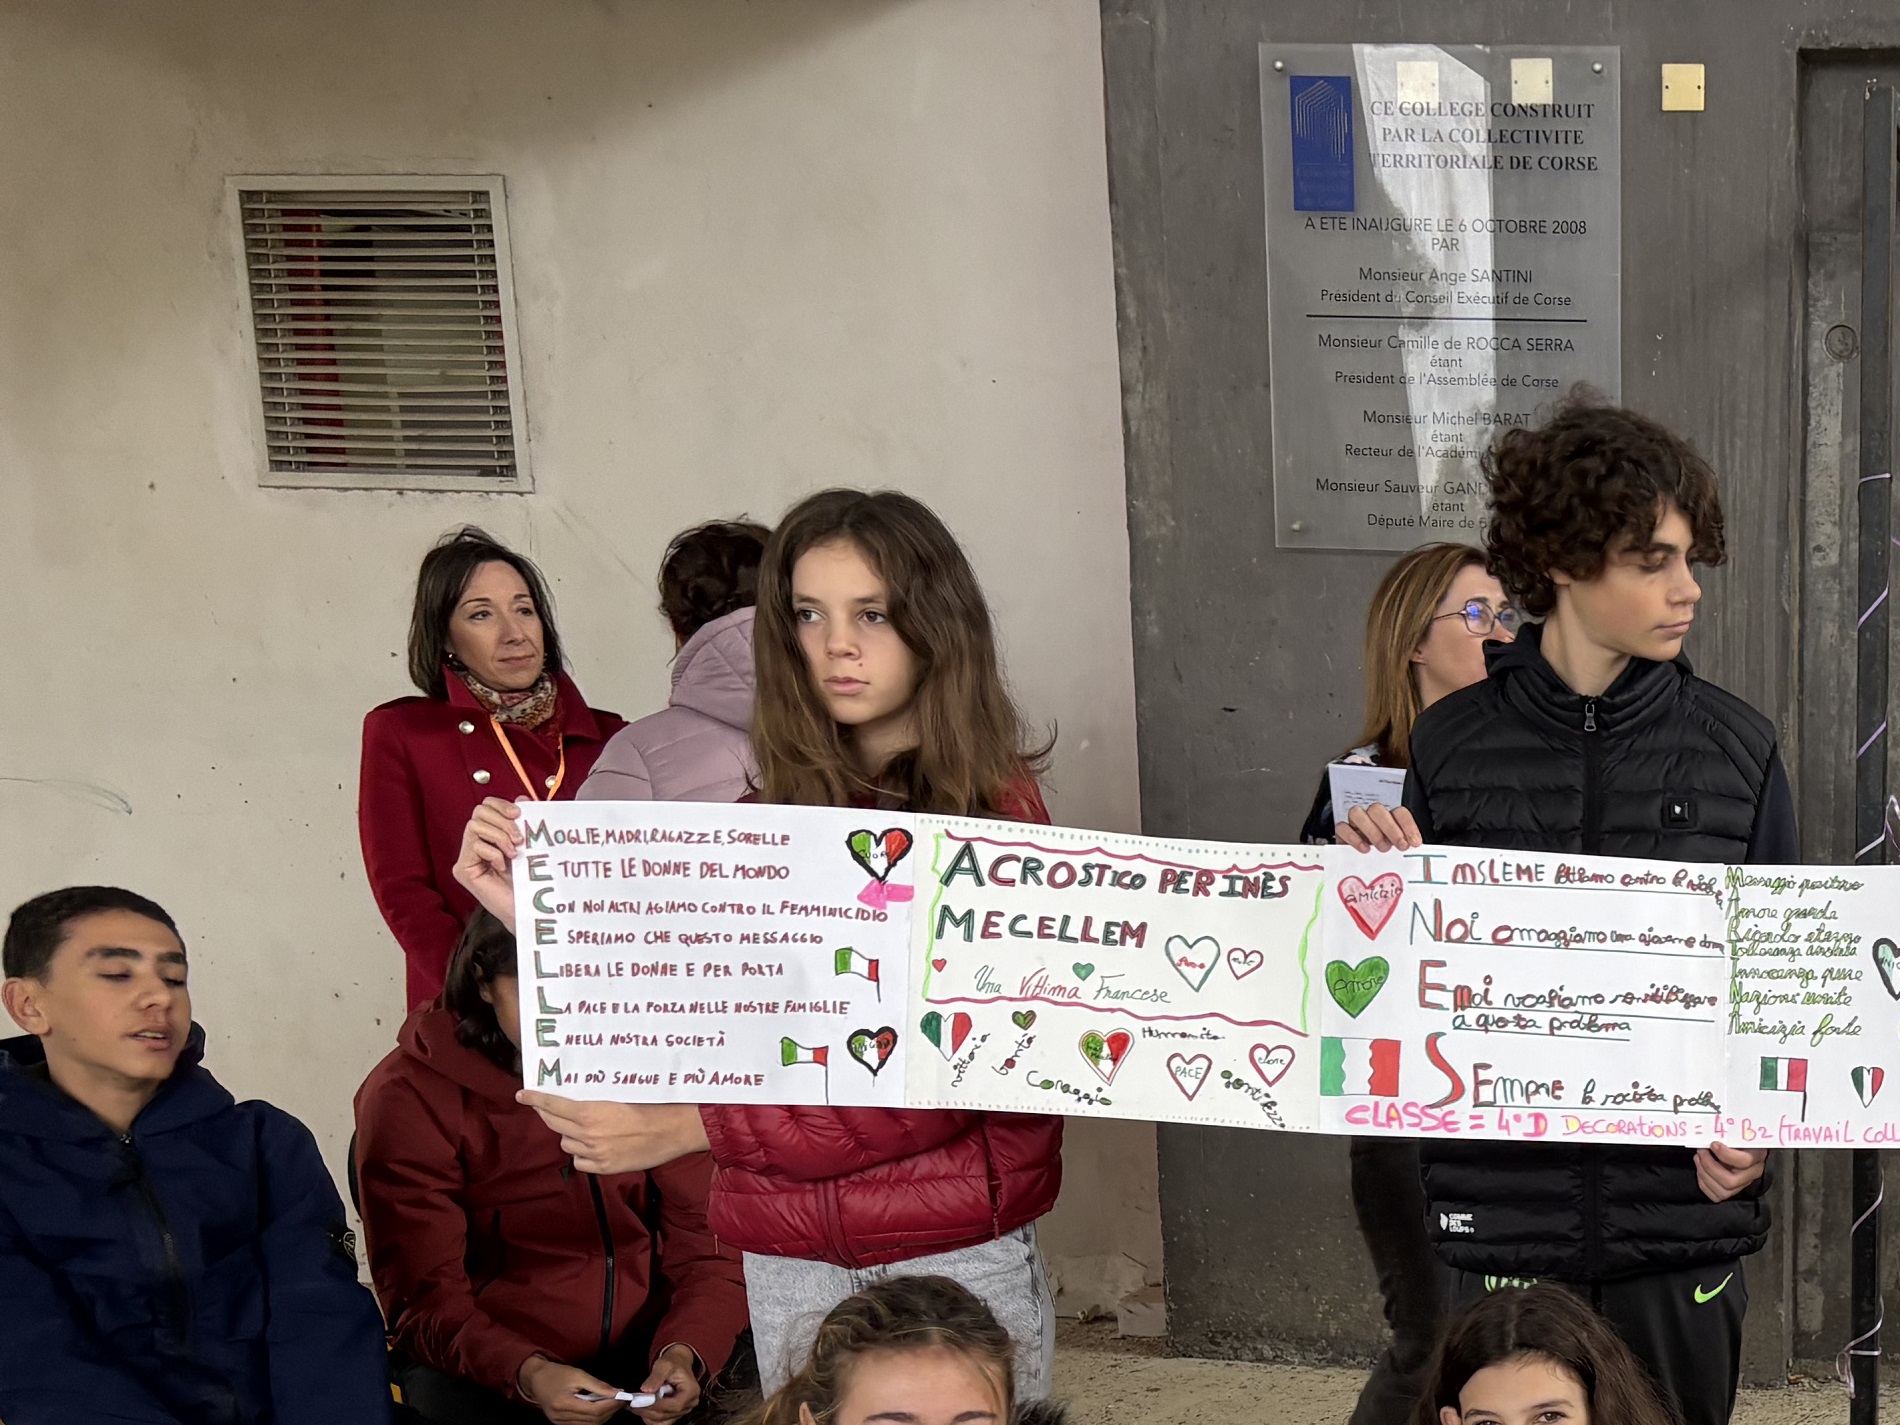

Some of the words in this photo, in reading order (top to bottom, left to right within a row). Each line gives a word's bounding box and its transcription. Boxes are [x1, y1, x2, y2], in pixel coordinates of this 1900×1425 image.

[1370, 102, 1395, 116] CE
[1399, 102, 1486, 118] COLLEGE
[1491, 103, 1595, 119] CONSTRUIT
[1382, 128, 1417, 142] PAR
[1421, 128, 1444, 143] LA
[1448, 129, 1584, 144] COLLECTIVITE
[1369, 153, 1504, 170] TERRITORIALE
[1510, 155, 1533, 170] DE
[1537, 155, 1598, 171] CORSE
[1305, 218, 1316, 230] A
[1320, 218, 1346, 231] ETE
[1353, 218, 1432, 232] INAUGURE
[1437, 219, 1454, 232] LE
[1458, 219, 1467, 232] 6
[1471, 219, 1547, 234] OCTOBRE
[1552, 220, 1587, 235] 2008
[1431, 237, 1459, 251] PAR
[1359, 267, 1423, 282] Monsieur
[1429, 268, 1467, 286] Ange
[1471, 269, 1532, 283] SANTINI
[1321, 289, 1381, 302] Président
[1405, 290, 1454, 304] Conseil
[1457, 290, 1509, 305] Exécutif
[1513, 292, 1529, 305] de
[1533, 294, 1572, 307] Corse
[1318, 335, 1383, 349] Monsieur
[1387, 336, 1439, 350] Camille
[1443, 336, 1462, 350] de
[1467, 336, 1522, 351] ROCCA
[1527, 338, 1574, 352] SERRA
[1430, 355, 1462, 368] étant
[1335, 371, 1396, 385] Président
[1399, 372, 1416, 385] de
[1419, 372, 1497, 387] l'Assemblée
[1501, 374, 1517, 387] de
[1522, 375, 1559, 389] Corse
[1363, 410, 1428, 425] Monsieur
[1432, 411, 1479, 426] Michel
[1483, 413, 1532, 427] BARAT
[1431, 430, 1463, 443] étant
[727, 829, 791, 846] SORELLE
[526, 854, 553, 881] E
[558, 861, 612, 878] TUTTE
[621, 858, 637, 877] LE
[642, 861, 691, 878] DONNE
[700, 862, 729, 879] DEL
[733, 862, 790, 880] MONDO
[940, 841, 1147, 891] ACROSTICO
[1159, 869, 1215, 898] PER
[1218, 872, 1291, 900] INÈS
[532, 887, 576, 914] CON
[583, 901, 606, 913] NOI
[609, 901, 641, 915] ALTRI
[645, 902, 698, 915] AGIAMO
[702, 903, 756, 915] CONTRO
[763, 902, 775, 915] IL
[779, 901, 889, 923] FEMMINICIDIO
[535, 919, 558, 945] E
[567, 930, 636, 944] SPERIAMO
[645, 931, 671, 944] CHE
[678, 932, 733, 946] QUESTO
[740, 932, 823, 944] MESSAGGIO
[936, 905, 1148, 949] MECELLEM
[534, 951, 601, 979] LIBERA
[607, 962, 624, 977] LE
[631, 962, 678, 977] DONNE
[687, 963, 695, 976] E
[703, 963, 732, 977] PER
[742, 962, 784, 976] PORTA
[975, 965, 1002, 995] Una
[1094, 974, 1172, 1004] Francese
[537, 986, 572, 1015] LA
[623, 1002, 641, 1014] LA
[646, 1001, 686, 1014] FORZA
[689, 1002, 728, 1014] NELLE
[734, 1002, 779, 1014] NOSTRE
[784, 1001, 850, 1015] FAMIGLIE
[536, 1019, 560, 1047] E
[565, 1034, 603, 1046] NELLA
[610, 1034, 658, 1047] NOSTRA
[665, 1030, 725, 1047] SOCIETÀ
[538, 1058, 578, 1087] MAI
[612, 1073, 660, 1085] SANGUE
[669, 1074, 677, 1085] E
[709, 1072, 764, 1086] AMORE
[1174, 1066, 1203, 1079] PACE
[1345, 1103, 1461, 1129] CLASSE
